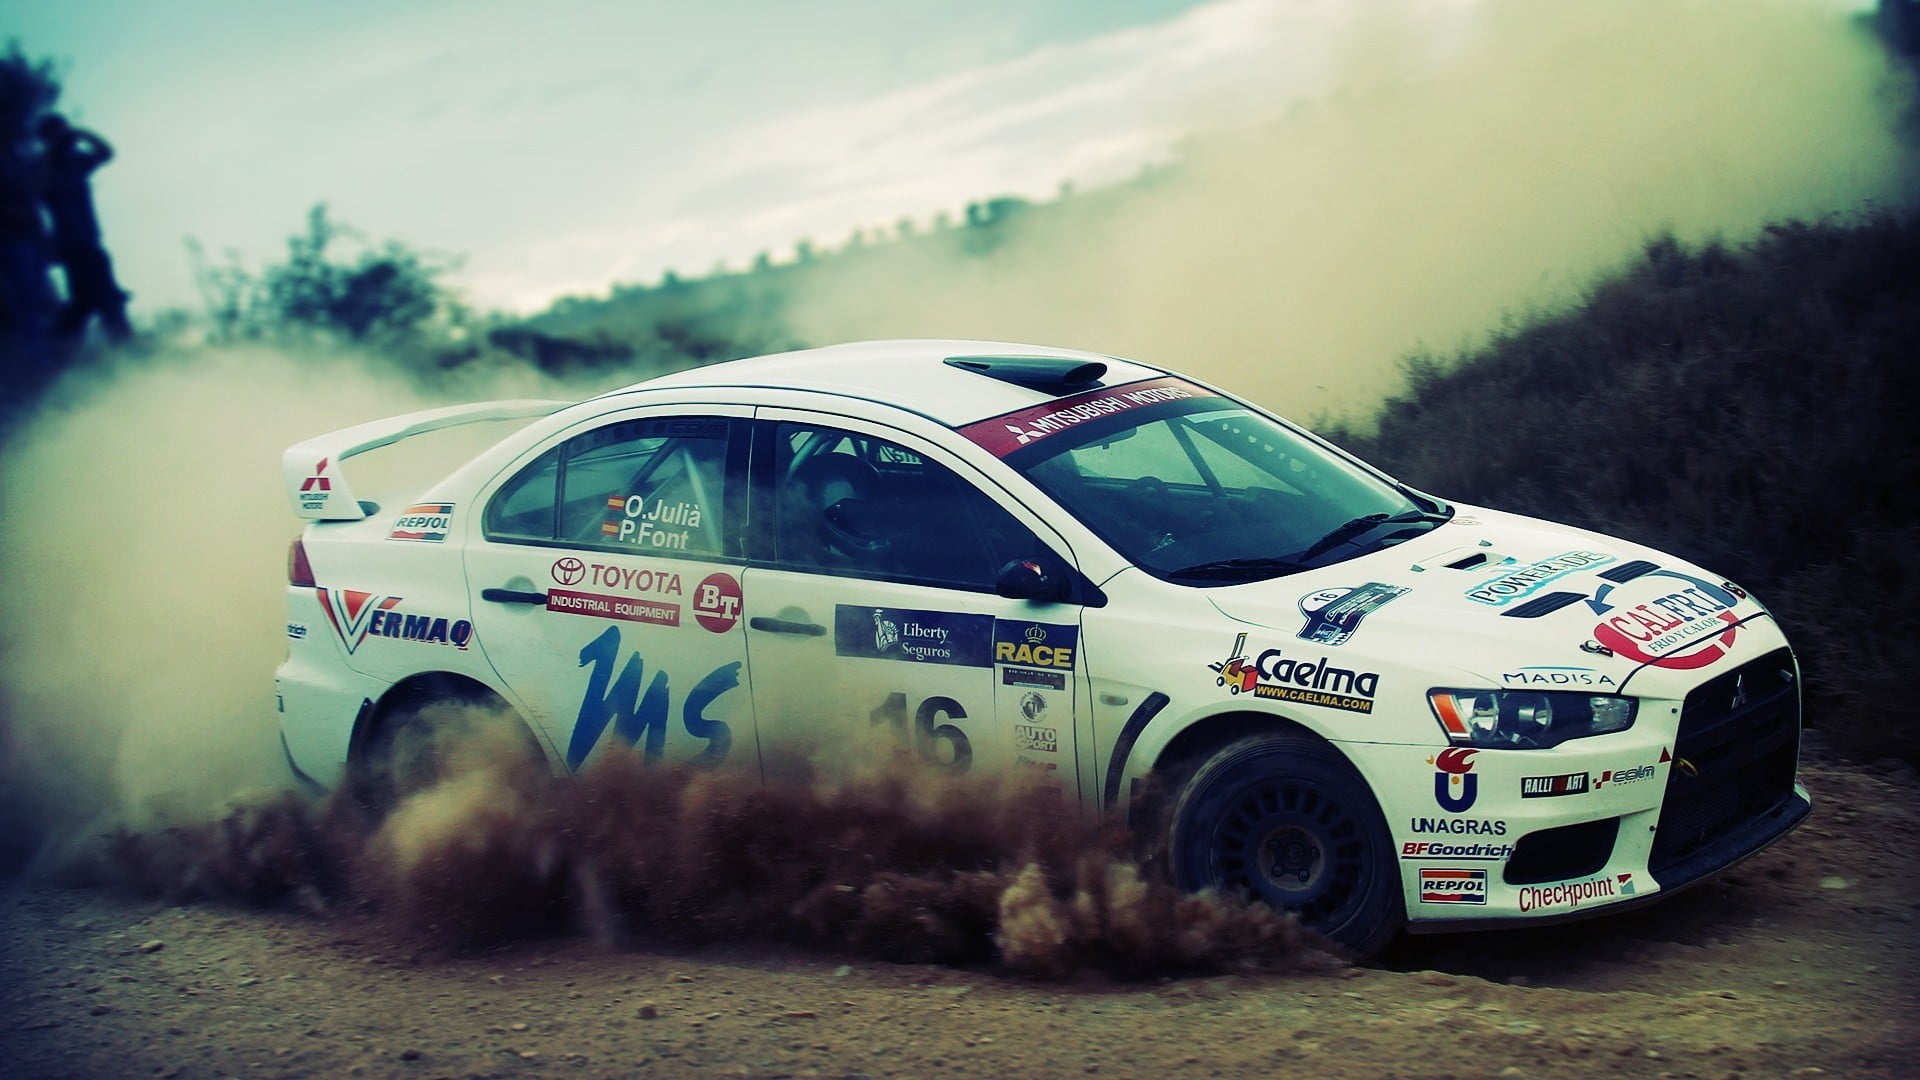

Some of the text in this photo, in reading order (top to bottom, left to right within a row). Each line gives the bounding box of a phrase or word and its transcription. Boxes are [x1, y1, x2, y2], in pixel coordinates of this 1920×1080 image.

[1029, 387, 1192, 434] MITSUBISHI MOTORS
[395, 515, 449, 530] REPSOL
[625, 495, 701, 529] O.Julià
[619, 519, 689, 549] P.Font
[591, 563, 683, 596] TOYOTA
[550, 595, 676, 621] INDUSTRIAL EQUIPMENT
[1610, 588, 1726, 641] CALFRI
[903, 622, 949, 643] Liberty
[1648, 634, 1676, 652] FRIO
[1683, 617, 1721, 635] CALOR
[902, 642, 951, 661] Seguros
[996, 641, 1072, 667] RACE
[1255, 648, 1379, 698] Caelma
[1503, 671, 1616, 687] MADISA
[1256, 685, 1371, 711] WWW.CAELMA.COM
[869, 691, 973, 776] 16
[1016, 726, 1056, 741] AUTO
[1411, 818, 1506, 836] UNAGRAS
[1402, 842, 1513, 857] BFGoodrich
[1423, 880, 1484, 891] REPSOL
[1519, 877, 1614, 913] Checkpoint
